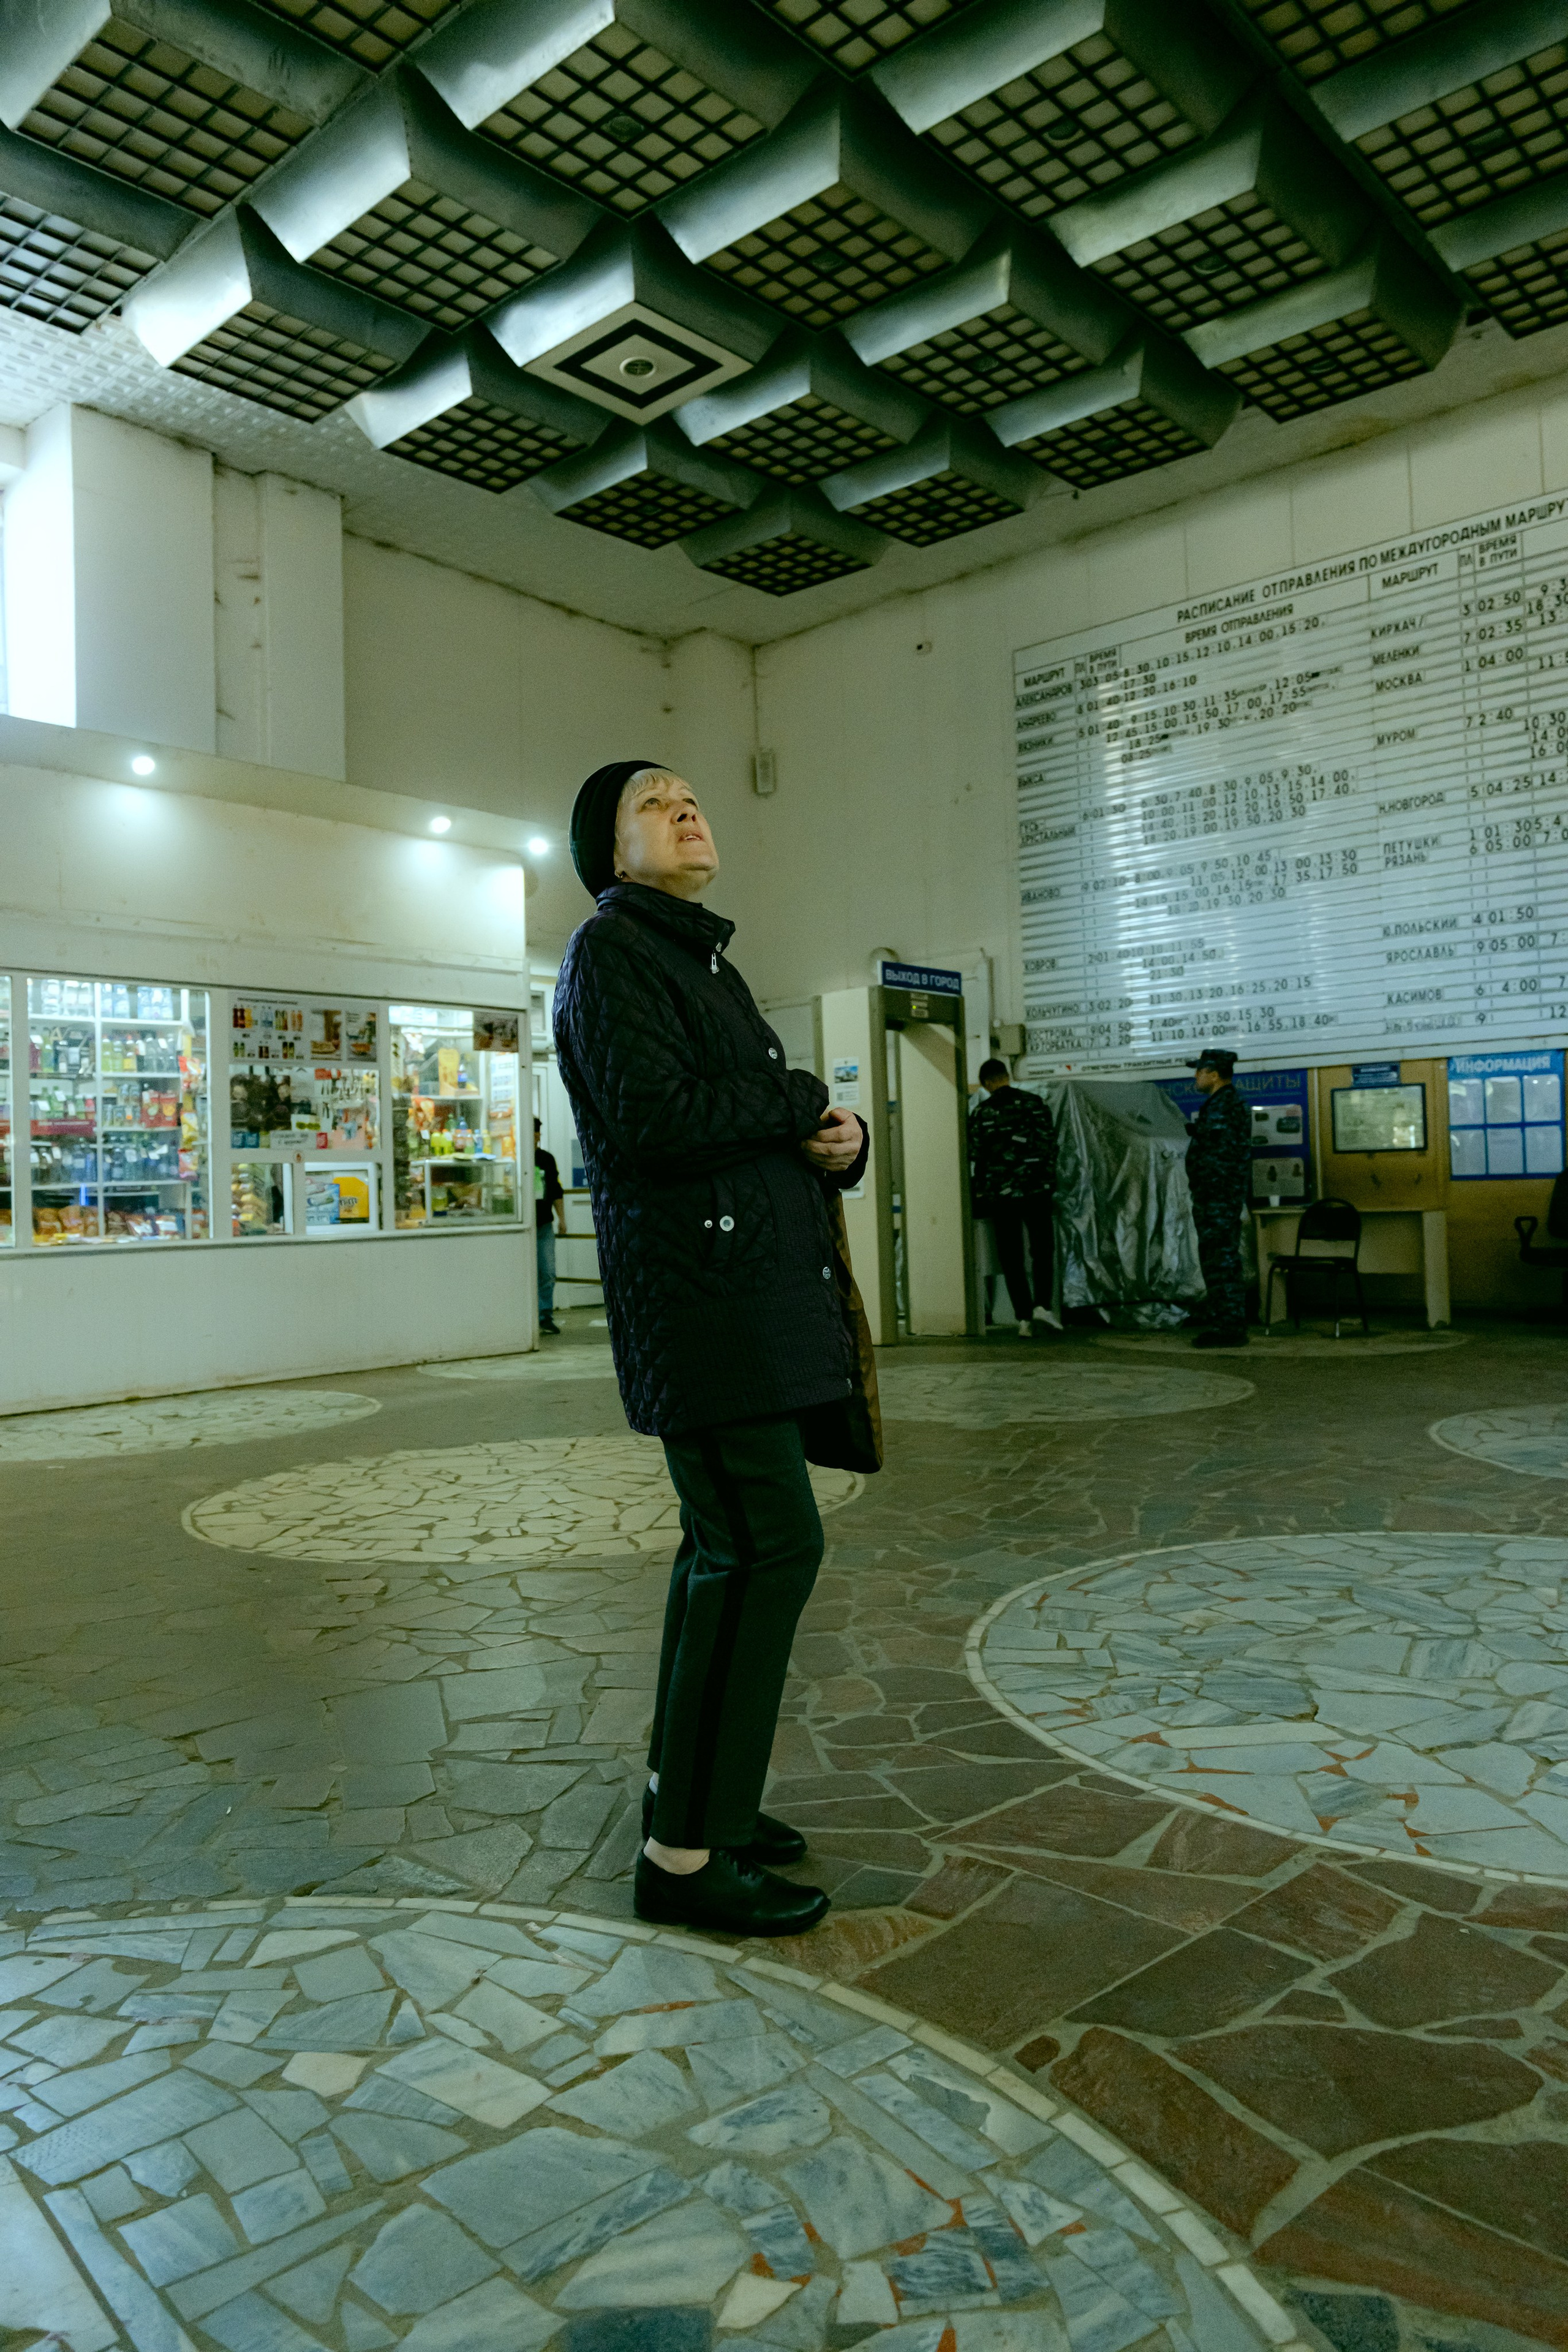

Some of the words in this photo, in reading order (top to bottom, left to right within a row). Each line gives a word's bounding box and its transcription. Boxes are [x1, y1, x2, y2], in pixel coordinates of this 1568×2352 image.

[1479, 535, 1517, 554] ВРЕМЯ
[1177, 589, 1255, 623] РАСПИСАНИЕ
[1262, 560, 1355, 598] ОТПРАВЛЕНИЯ
[1359, 554, 1378, 571] ПО
[1379, 518, 1501, 565] МЕЖДУГОРОДНЫМ
[1506, 497, 1568, 528] МАРШРУ
[1490, 549, 1517, 563] ПУТИ
[1382, 563, 1438, 589] МАРШРУТ
[1221, 603, 1294, 633] ОТПРАВЛЕНИЯ
[1375, 673, 1422, 693] МОСКВА
[1478, 646, 1524, 669] 04:00
[1376, 728, 1415, 746] МУРОМ
[1384, 835, 1439, 855] ПЕТУШКИ
[1386, 946, 1454, 964] ЯРОСЛАВЛЬ
[1490, 934, 1536, 952] 05:00
[885, 968, 919, 986] ВЫХОД
[921, 973, 929, 985] В
[931, 974, 960, 990] ГОРОД
[1387, 988, 1442, 1006] КАСИМОВ
[1456, 1055, 1552, 1074] ИНФОРМАЦИЯ
[1235, 1073, 1302, 1091] АЩИТЫ
